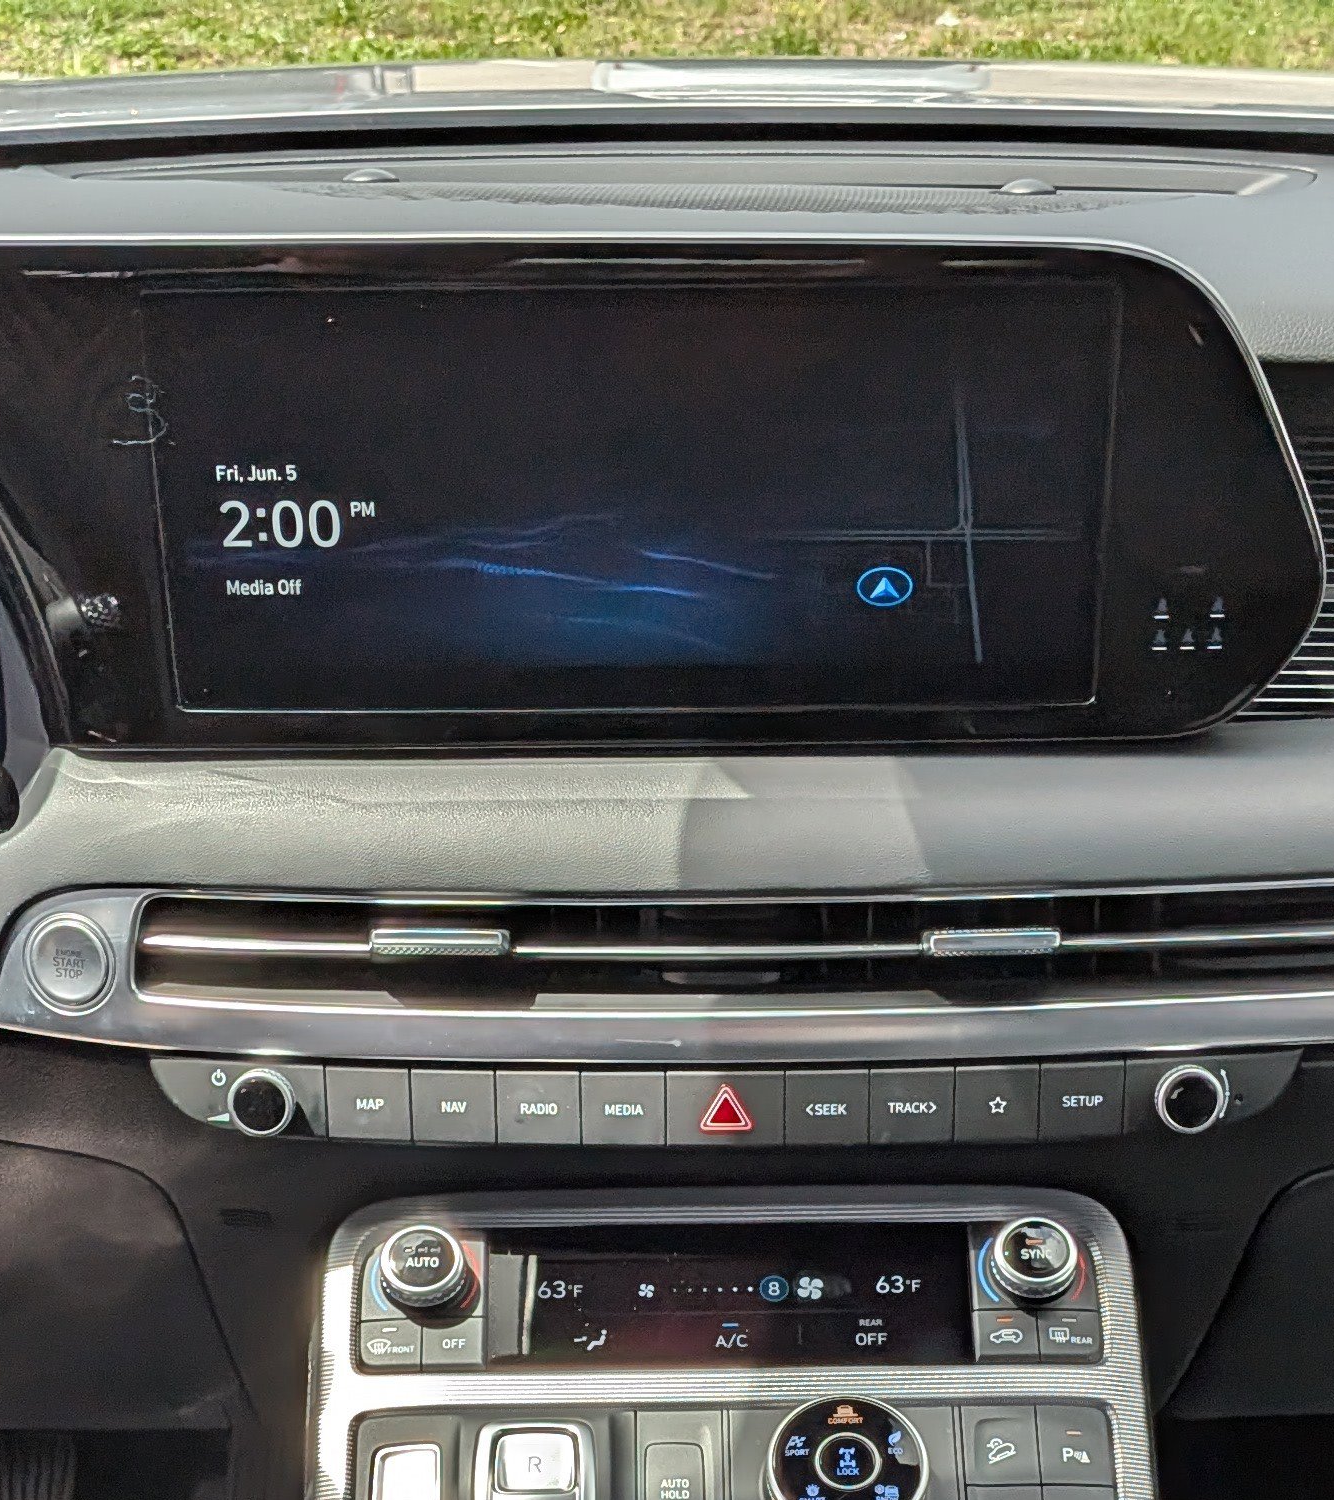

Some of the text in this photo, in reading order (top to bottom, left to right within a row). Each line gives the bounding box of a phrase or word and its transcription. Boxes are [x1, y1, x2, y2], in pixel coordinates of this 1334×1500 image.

[215, 464, 297, 483] Fri, Jun. 5
[219, 500, 376, 548] 2:00 PM
[226, 579, 302, 595] Media Off
[53, 957, 85, 969] START
[56, 968, 83, 979] STOP
[356, 1098, 384, 1111] MAP
[1062, 1095, 1103, 1108] SETUP
[441, 1101, 467, 1114] NAV
[520, 1103, 558, 1115] RADIO
[604, 1105, 644, 1116] MEDIA
[1020, 1248, 1052, 1260] SYNC
[405, 1257, 440, 1268] AUTO
[768, 1281, 780, 1296] 8
[858, 1318, 883, 1327] REAR
[442, 1339, 466, 1349] OFF
[715, 1333, 749, 1349] A/C
[855, 1332, 888, 1346] OFF
[1070, 1336, 1093, 1345] REAR
[387, 1345, 415, 1354] FRONT
[827, 1416, 864, 1425] COMFORT
[784, 1447, 810, 1456] SPORT
[887, 1447, 904, 1455] ECO
[528, 1456, 543, 1473] R
[836, 1467, 860, 1476] LOCK
[660, 1479, 690, 1489] AUTO
[660, 1489, 690, 1500] HOLD
